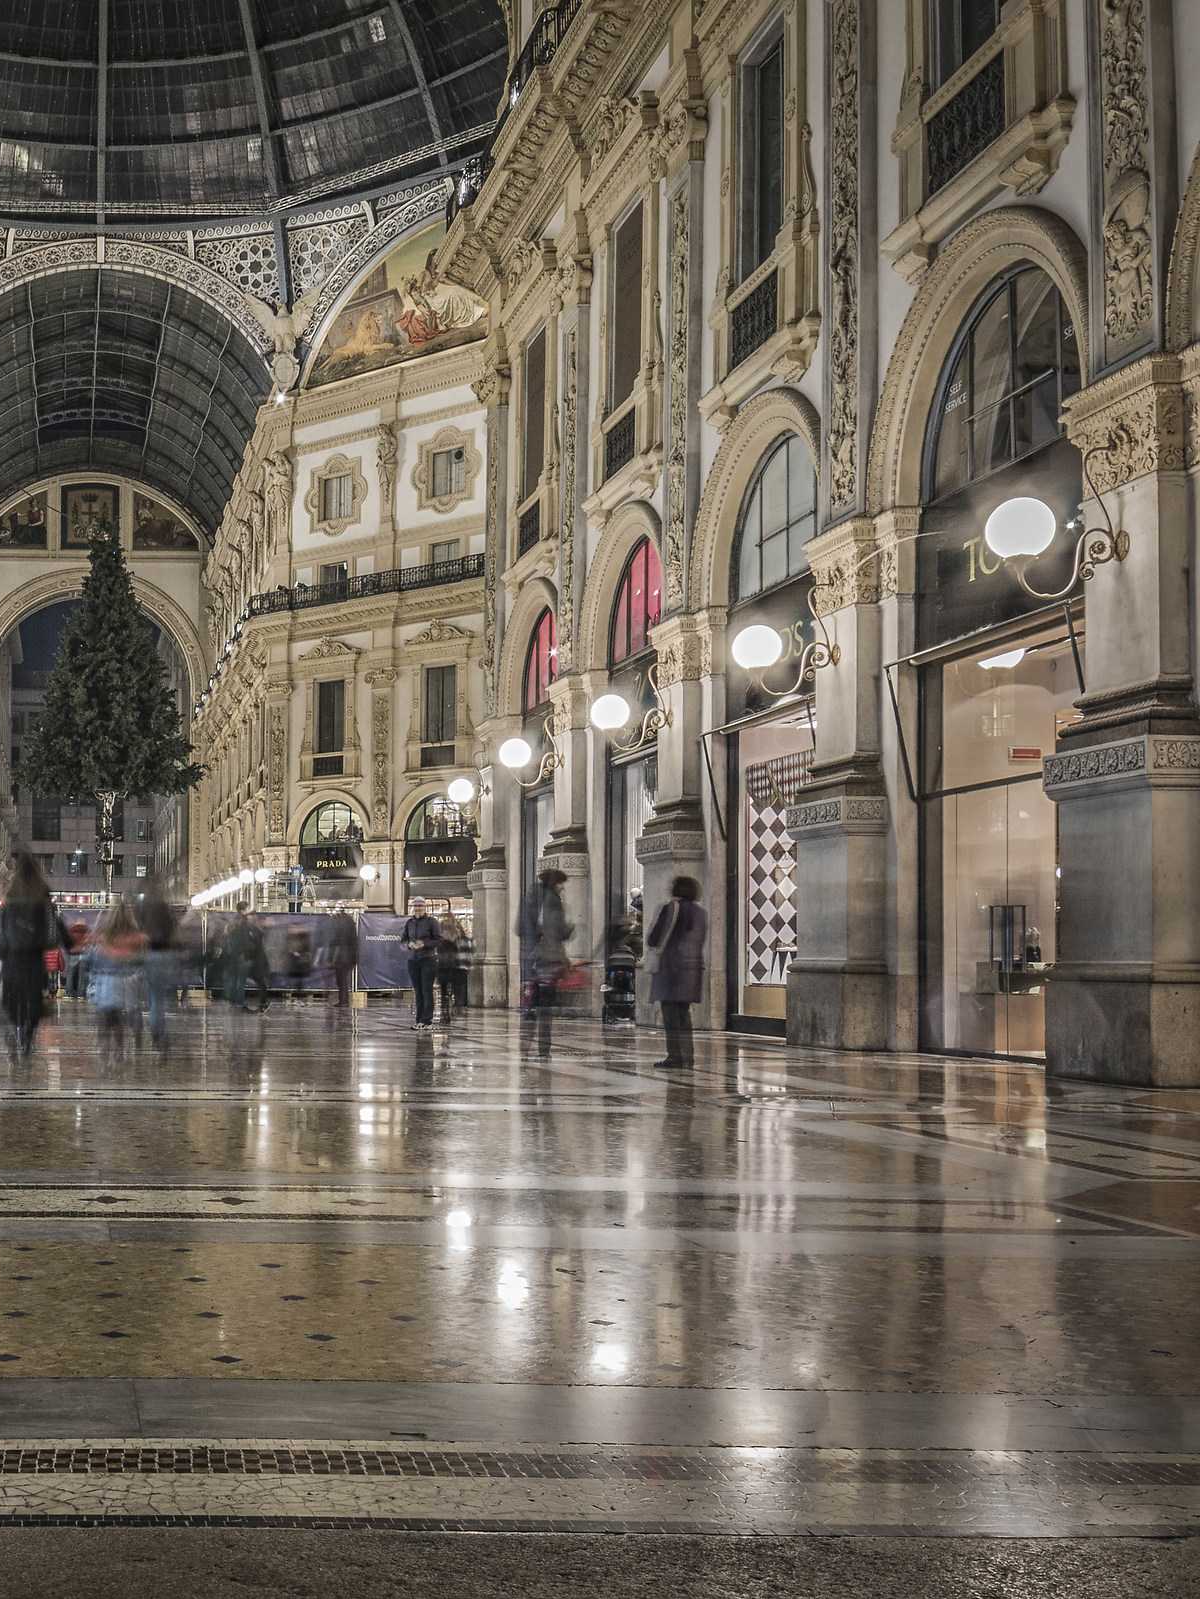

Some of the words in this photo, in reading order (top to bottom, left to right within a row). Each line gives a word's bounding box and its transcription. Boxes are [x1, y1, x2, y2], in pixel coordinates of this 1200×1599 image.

[949, 380, 962, 396] SELF
[945, 392, 967, 414] SERVICE
[316, 859, 348, 868] PRADA
[424, 855, 459, 864] PRADA
